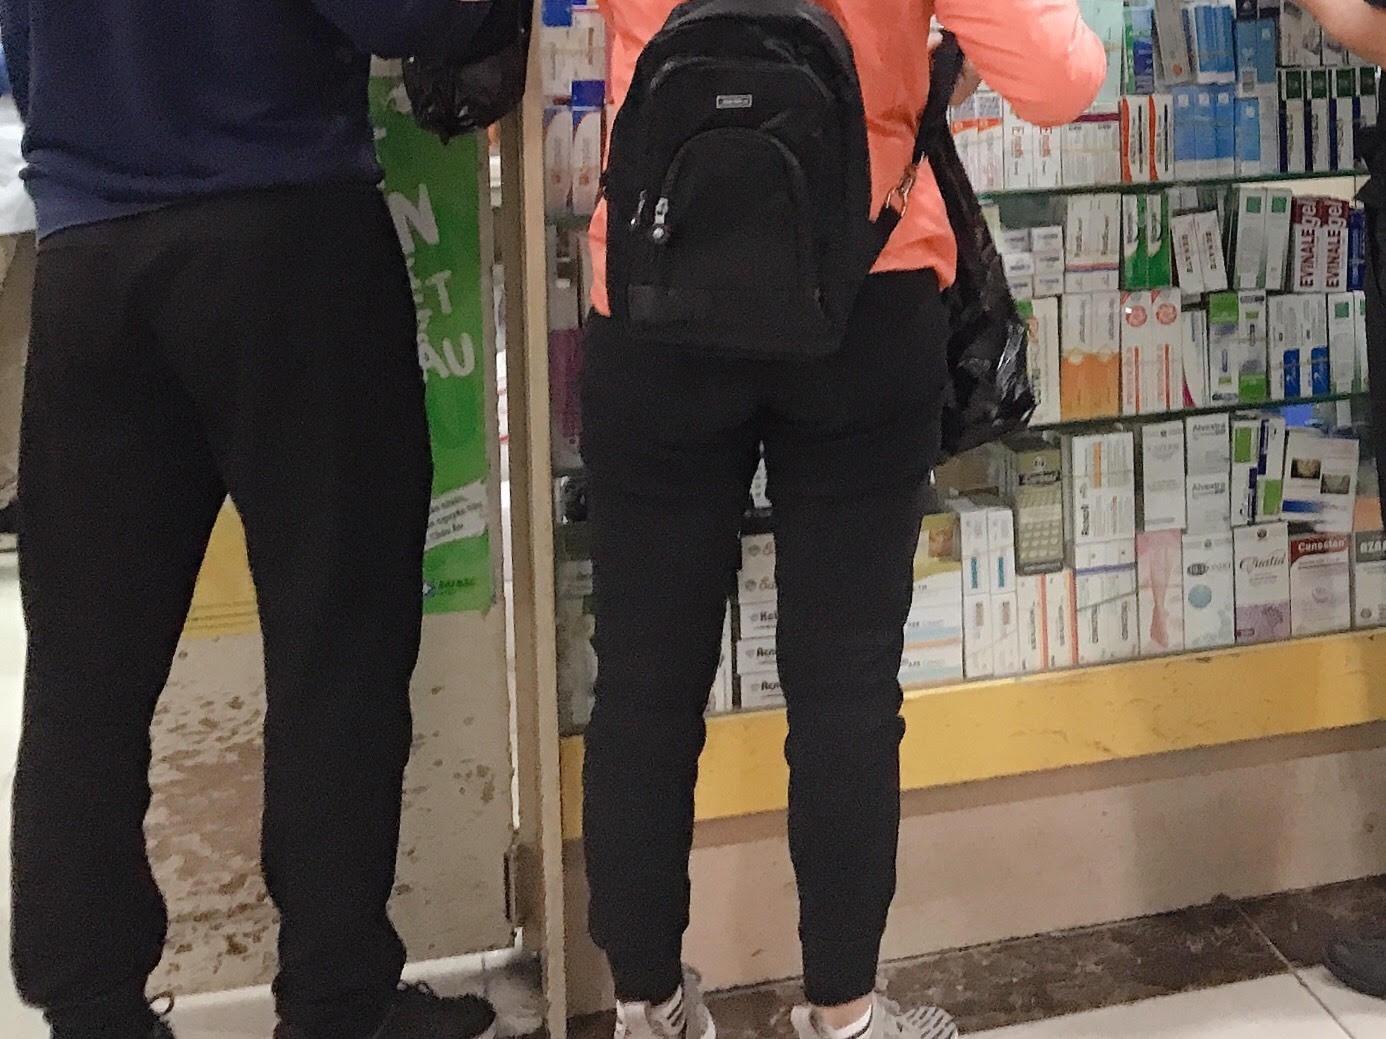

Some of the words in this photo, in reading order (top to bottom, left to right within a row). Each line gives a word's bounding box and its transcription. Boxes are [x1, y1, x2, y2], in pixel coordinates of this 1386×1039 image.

[1301, 197, 1321, 228] gel
[1328, 196, 1347, 227] gel
[1299, 228, 1315, 288] EVINALE
[1325, 228, 1341, 288] EVINALE
